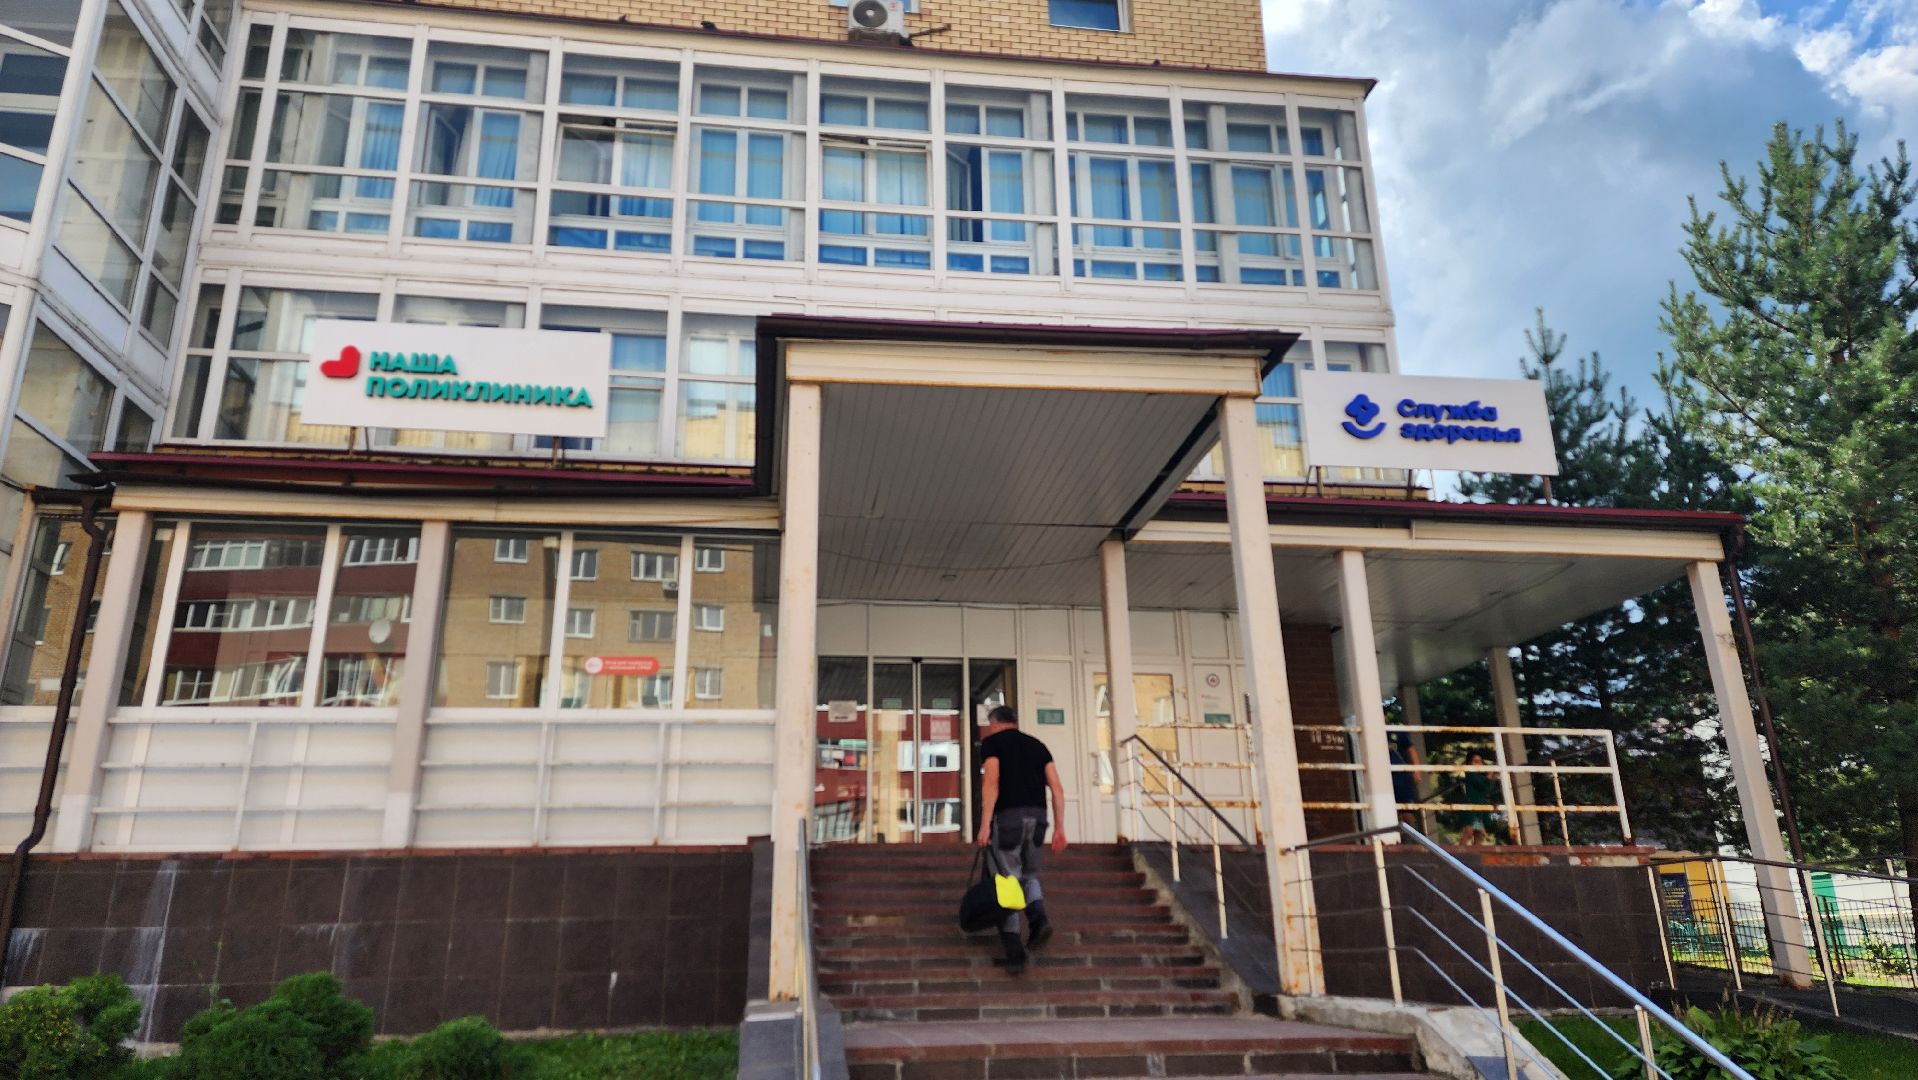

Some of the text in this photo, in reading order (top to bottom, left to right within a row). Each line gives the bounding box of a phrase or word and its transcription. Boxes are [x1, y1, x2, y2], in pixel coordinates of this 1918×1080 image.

[369, 352, 458, 375] НАША
[366, 376, 593, 408] ПОЛИКЛИНИКА
[1397, 398, 1498, 423] Служба
[1400, 423, 1522, 444] здоровья
